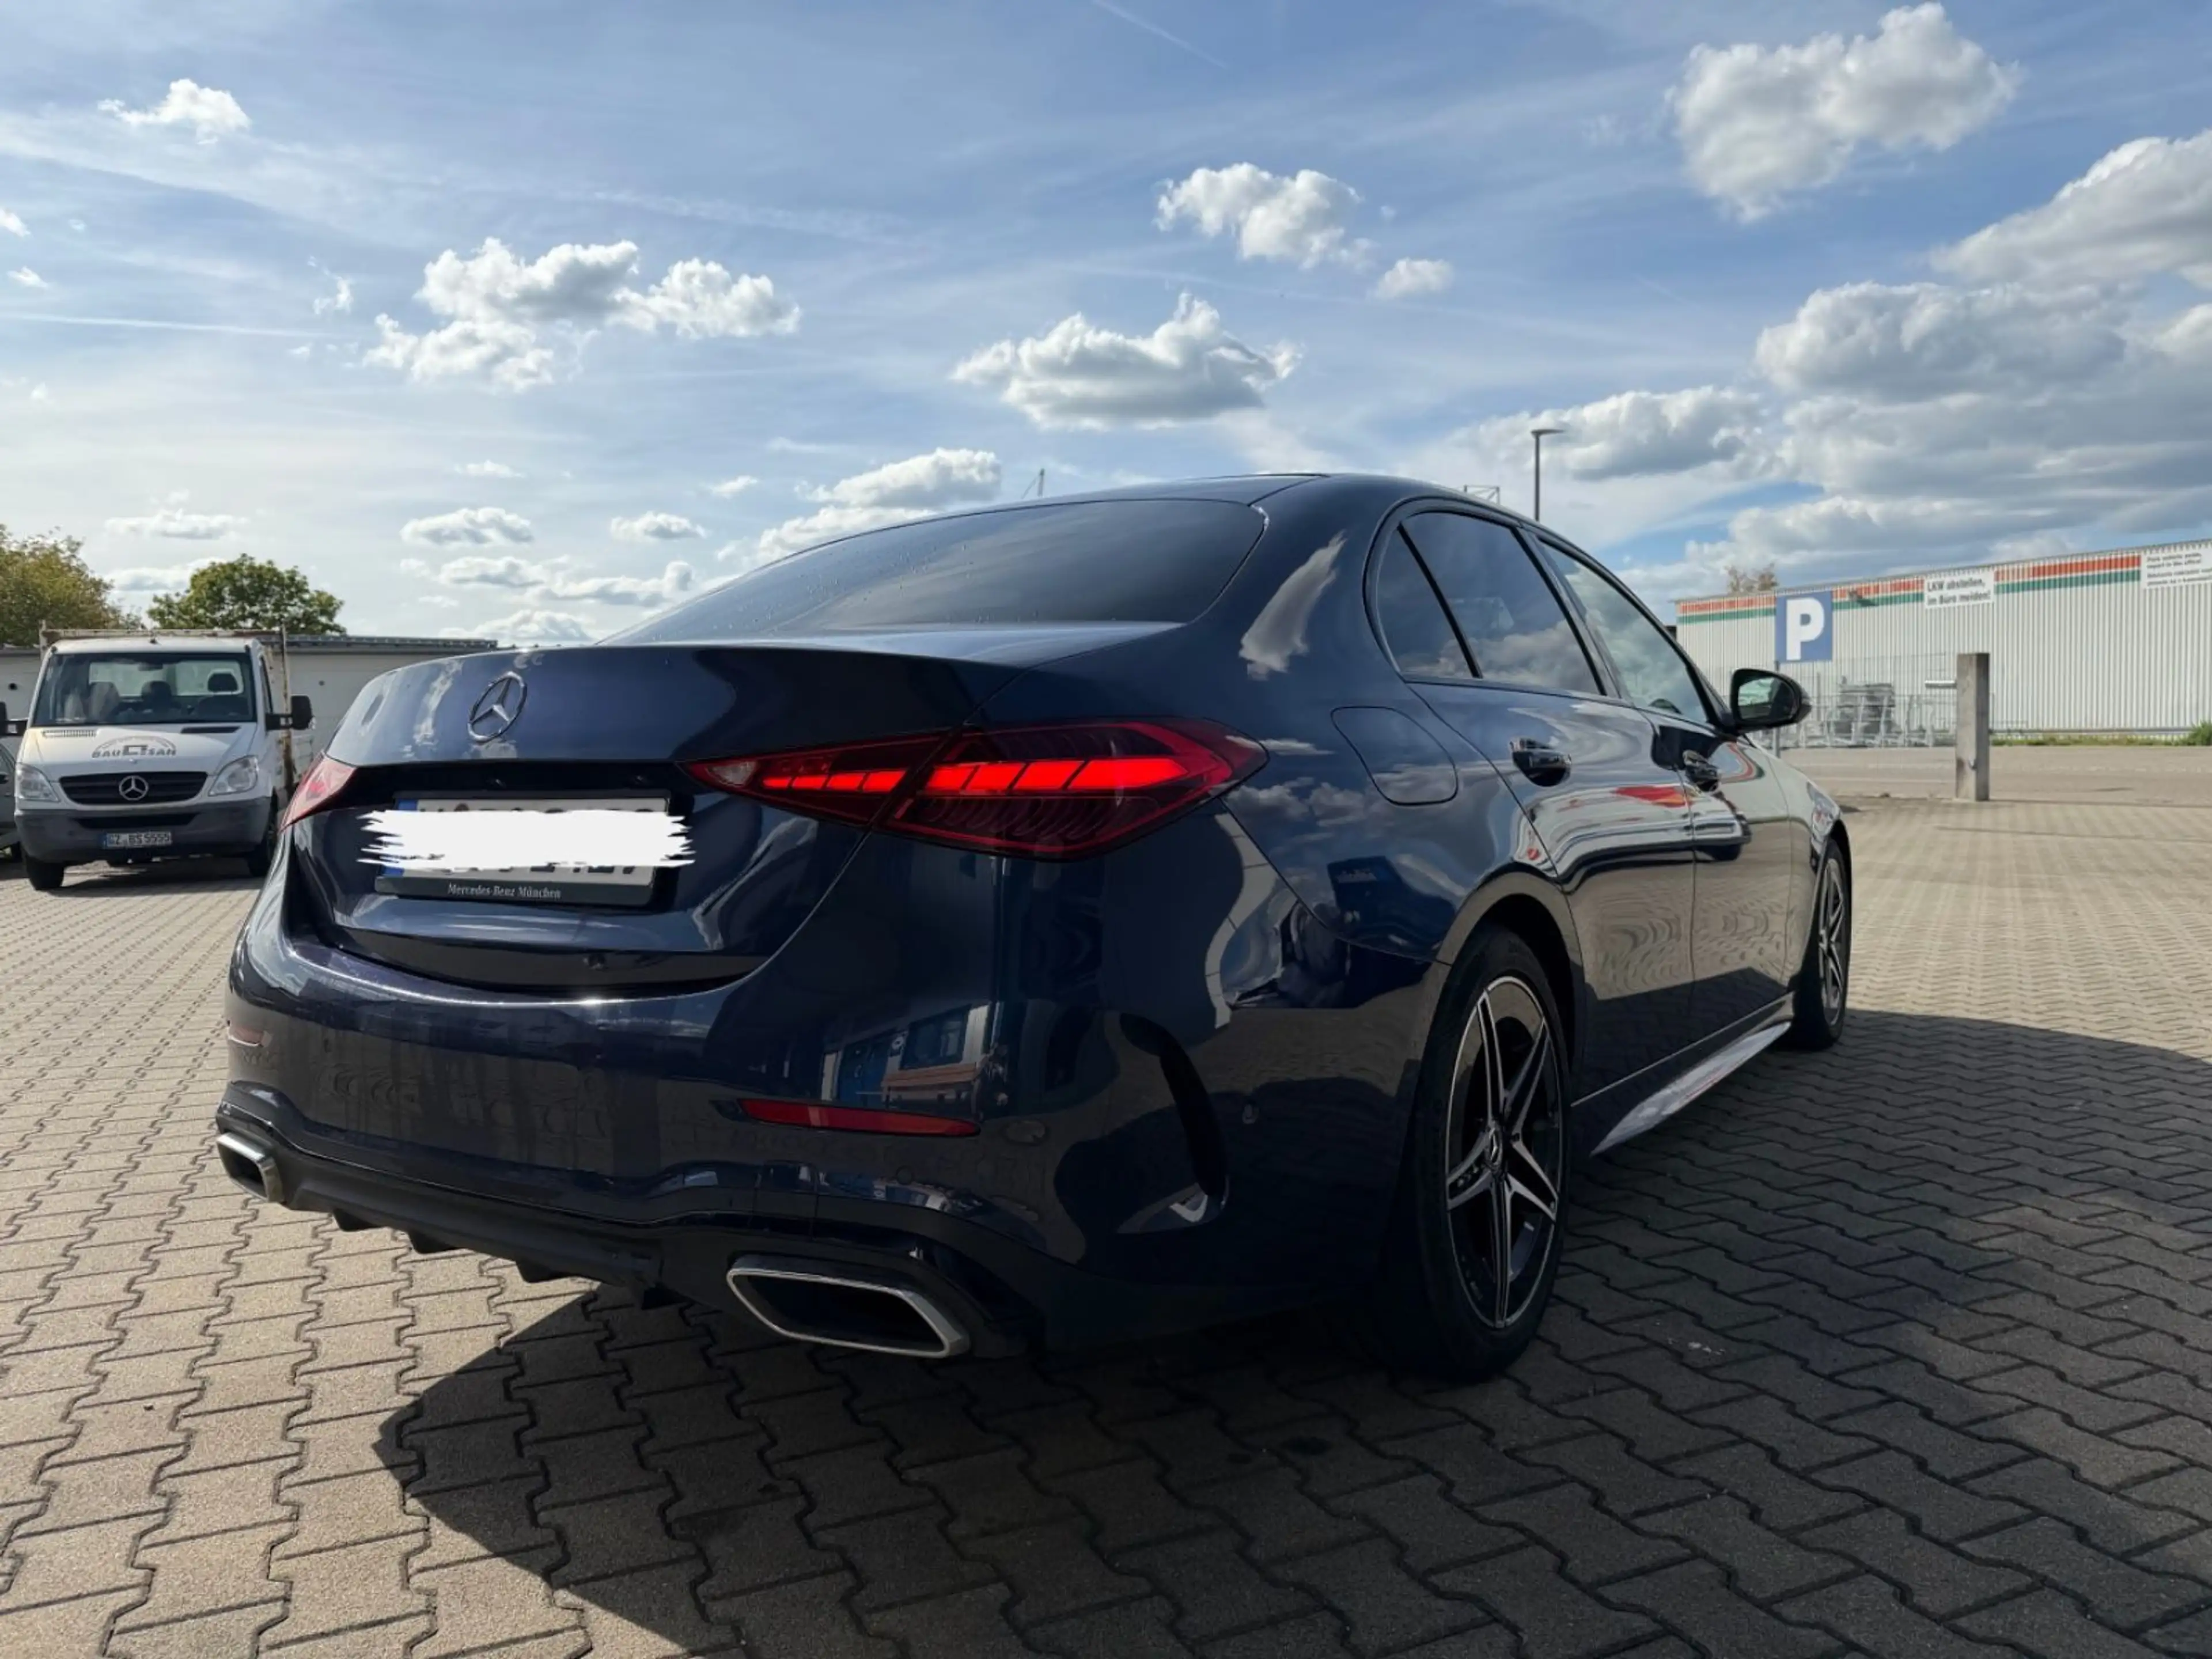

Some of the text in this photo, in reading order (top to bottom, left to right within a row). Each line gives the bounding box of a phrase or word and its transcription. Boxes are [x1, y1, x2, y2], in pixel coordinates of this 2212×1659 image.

[1927, 581, 1944, 592] LKW
[1786, 597, 1824, 660] P
[447, 882, 561, 899] Mercedes-Benz München
